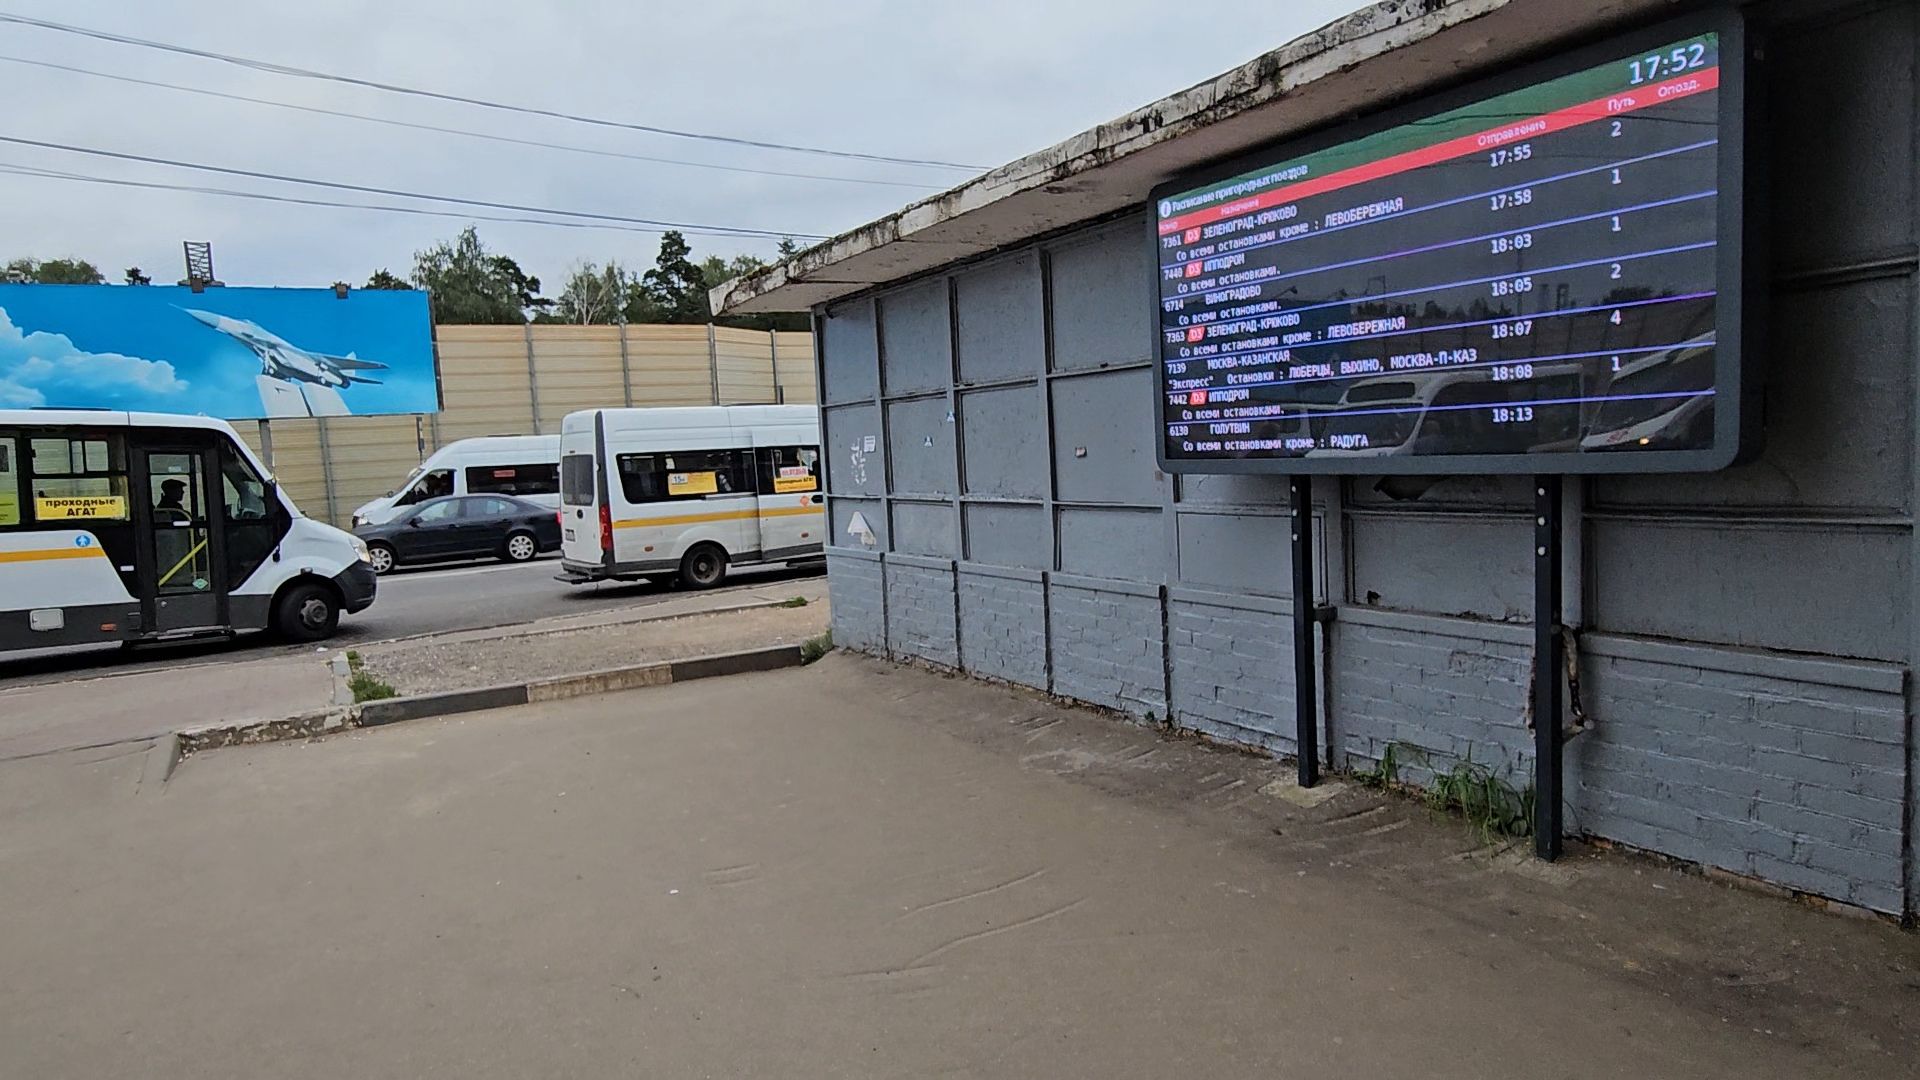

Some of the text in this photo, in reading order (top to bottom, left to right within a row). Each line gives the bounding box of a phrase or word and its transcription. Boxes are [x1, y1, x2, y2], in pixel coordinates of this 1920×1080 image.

[1629, 43, 1705, 85] 17:52
[1657, 79, 1701, 98] Опозд.
[1607, 98, 1635, 113] Путь
[1477, 119, 1547, 147] Отправление
[1611, 121, 1622, 137] 2
[1489, 144, 1532, 168] 17:55
[1611, 169, 1622, 184] 1
[1172, 164, 1309, 211] Расписание пригородных поездов
[1490, 188, 1532, 211] 17:58
[1163, 234, 1182, 249] 7361
[1203, 205, 1298, 240] ЗЕЛЕНОГРАД-КРЮКОВО
[1176, 250, 1187, 262] Со
[1190, 245, 1215, 259] всеми
[1218, 230, 1276, 251] остановками
[1279, 222, 1309, 239] кроме
[1324, 197, 1404, 228] ЛЕВОБЕРЕЖНАЯ
[1611, 216, 1621, 232] 1
[1491, 233, 1532, 254] 18:03
[1203, 253, 1245, 272] ИППОДРОМ
[1610, 264, 1621, 279] 2
[1177, 265, 1280, 293] Со всеми остановками.
[1491, 277, 1532, 296] 18:05
[1164, 285, 1262, 312] 6714 ВИНОГРАДОВО
[1178, 300, 1282, 326] Со всеми остановками.
[1610, 309, 1621, 325] 4
[1166, 331, 1185, 343] 7363
[1207, 313, 1300, 338] ЗЕЛЕНОГРАД-КРЮКОВО
[1179, 346, 1190, 357] Со
[1193, 341, 1218, 355] всеми
[1221, 335, 1279, 352] остановками
[1283, 331, 1312, 345] кроме
[1327, 316, 1406, 339] ЛЕВОБЕРЕЖНАЯ
[1491, 320, 1532, 339] 18:07
[1167, 350, 1290, 375] 7139 МОСКВА-КАЗАНСКАЯ
[1168, 375, 1214, 389] "Экспресс"
[1227, 371, 1275, 385] Остановки
[1288, 363, 1335, 379] ЛЮБЕРЦЫ,
[1340, 359, 1384, 375] ВЫХИНО,
[1390, 348, 1477, 369] МОСКВА-П-КАЗ
[1611, 356, 1621, 372] 1
[1492, 364, 1533, 381] 18:08
[1168, 395, 1188, 406] 7442
[1208, 389, 1250, 403] ИППОДРОМ
[1182, 404, 1285, 420] Со всеми остановками.
[1492, 407, 1533, 423] 18:13
[1209, 422, 1250, 435] ГОЛУТВИН
[1182, 441, 1194, 451] Со
[1196, 439, 1222, 451] всеми
[1224, 438, 1282, 450] остановками
[1285, 437, 1315, 451] кроме
[1330, 434, 1369, 449] РАДУГА
[45, 499, 116, 508] проходные
[66, 508, 97, 516] АГАТ
